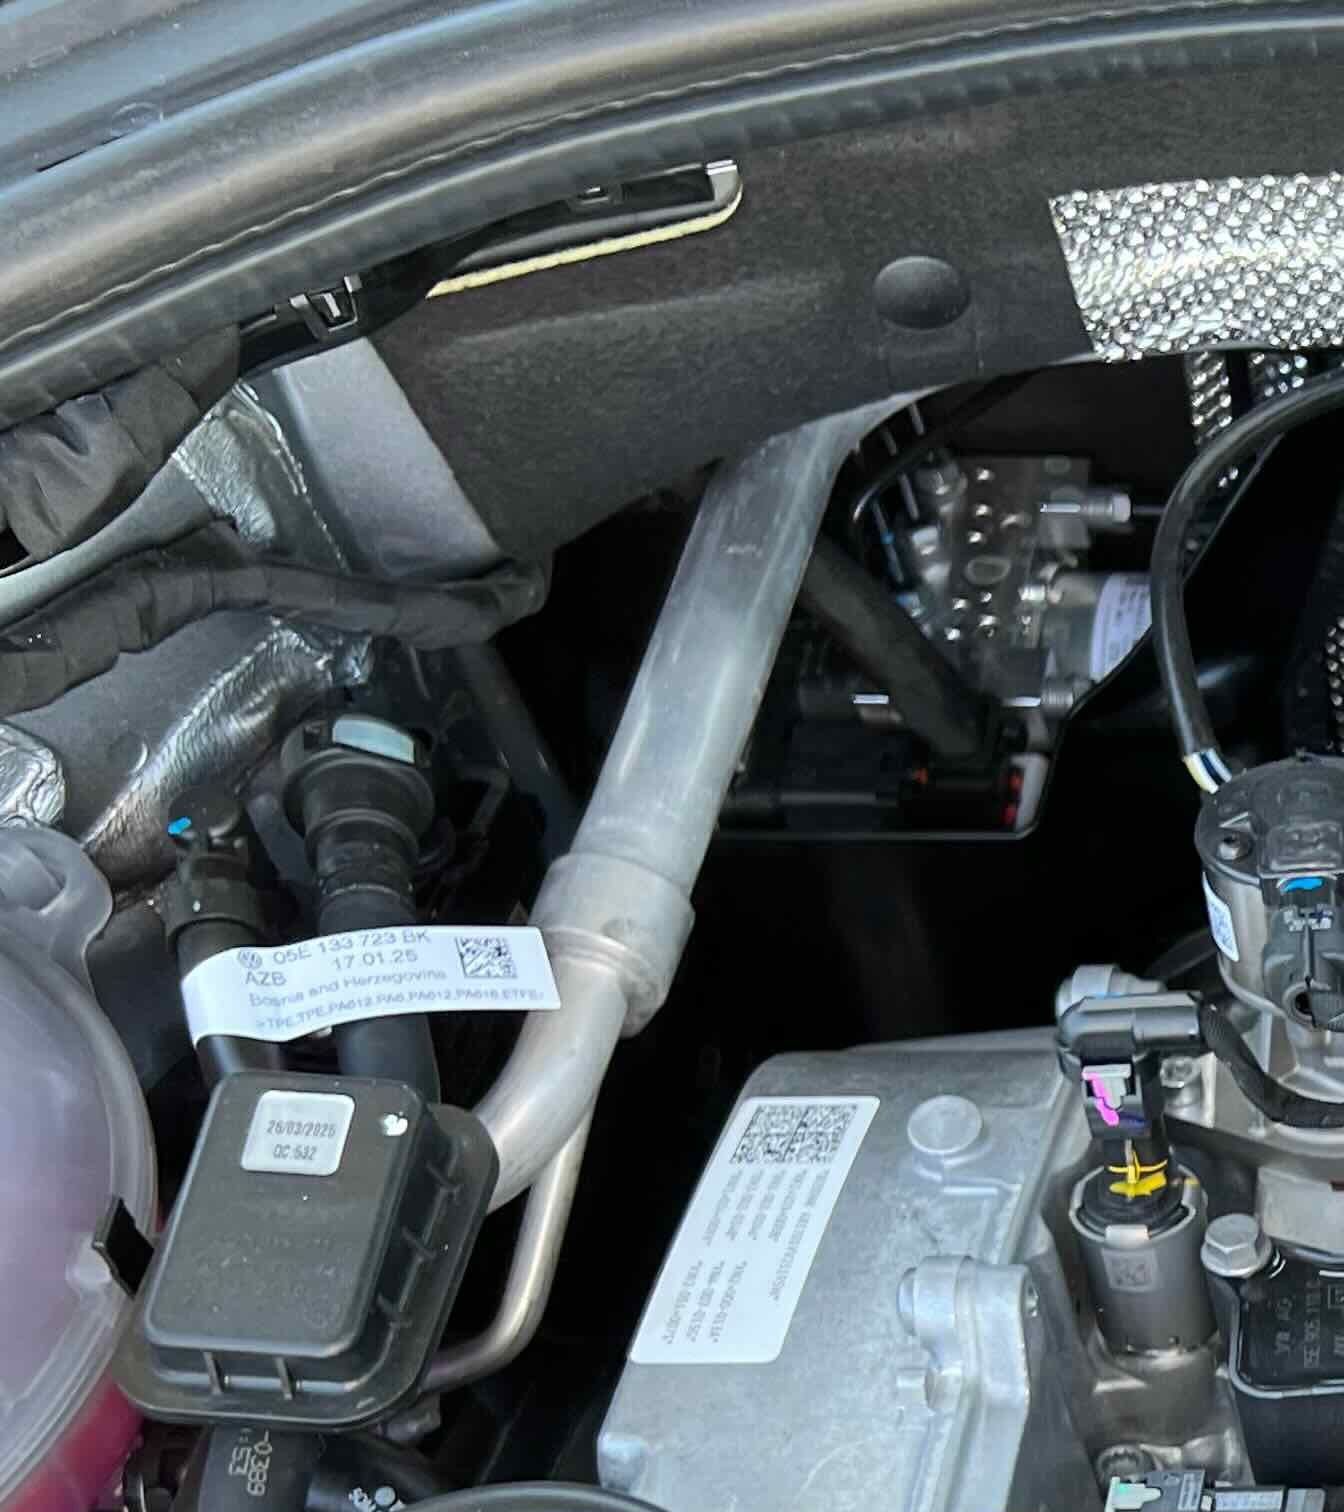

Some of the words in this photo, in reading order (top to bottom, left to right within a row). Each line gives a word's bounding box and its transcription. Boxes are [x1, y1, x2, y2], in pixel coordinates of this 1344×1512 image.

[273, 949, 312, 965] 05E
[318, 938, 353, 954] 133
[361, 933, 397, 949] 723
[308, 981, 340, 998] and
